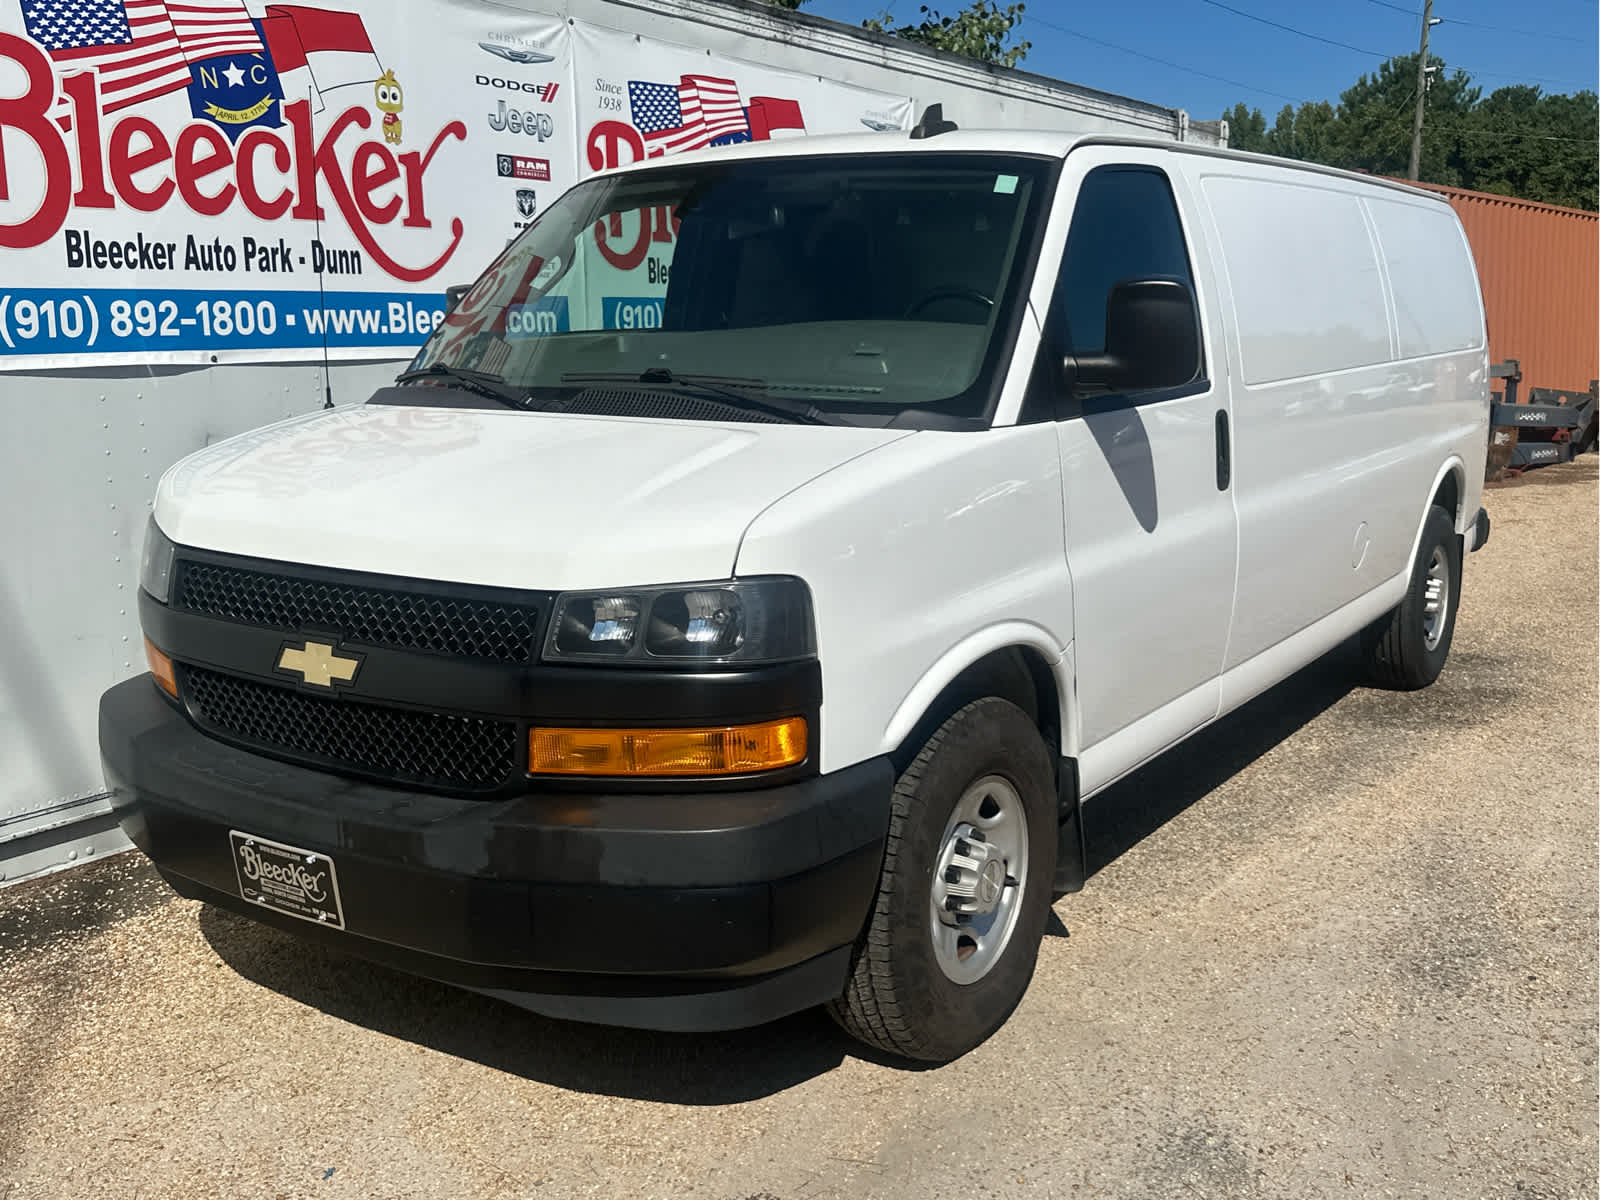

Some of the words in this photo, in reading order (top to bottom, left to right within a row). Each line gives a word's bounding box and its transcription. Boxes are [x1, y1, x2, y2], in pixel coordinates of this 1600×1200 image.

[200, 66, 219, 89] N
[250, 64, 268, 85] C
[475, 74, 549, 96] DODGE
[595, 78, 622, 95] Since
[217, 110, 240, 121] APRIL
[599, 96, 622, 111] 1938
[488, 99, 554, 142] Jeep
[0, 32, 467, 282] Bleecker
[516, 160, 548, 171] RAM
[64, 229, 176, 270] Bleecker
[184, 234, 237, 273] Auto
[243, 237, 294, 274] Park
[311, 239, 362, 275] Dunn
[0, 295, 98, 348] (910)
[110, 299, 277, 338] 892-1800
[615, 302, 662, 329] (910)
[240, 845, 327, 902] Bleecker
